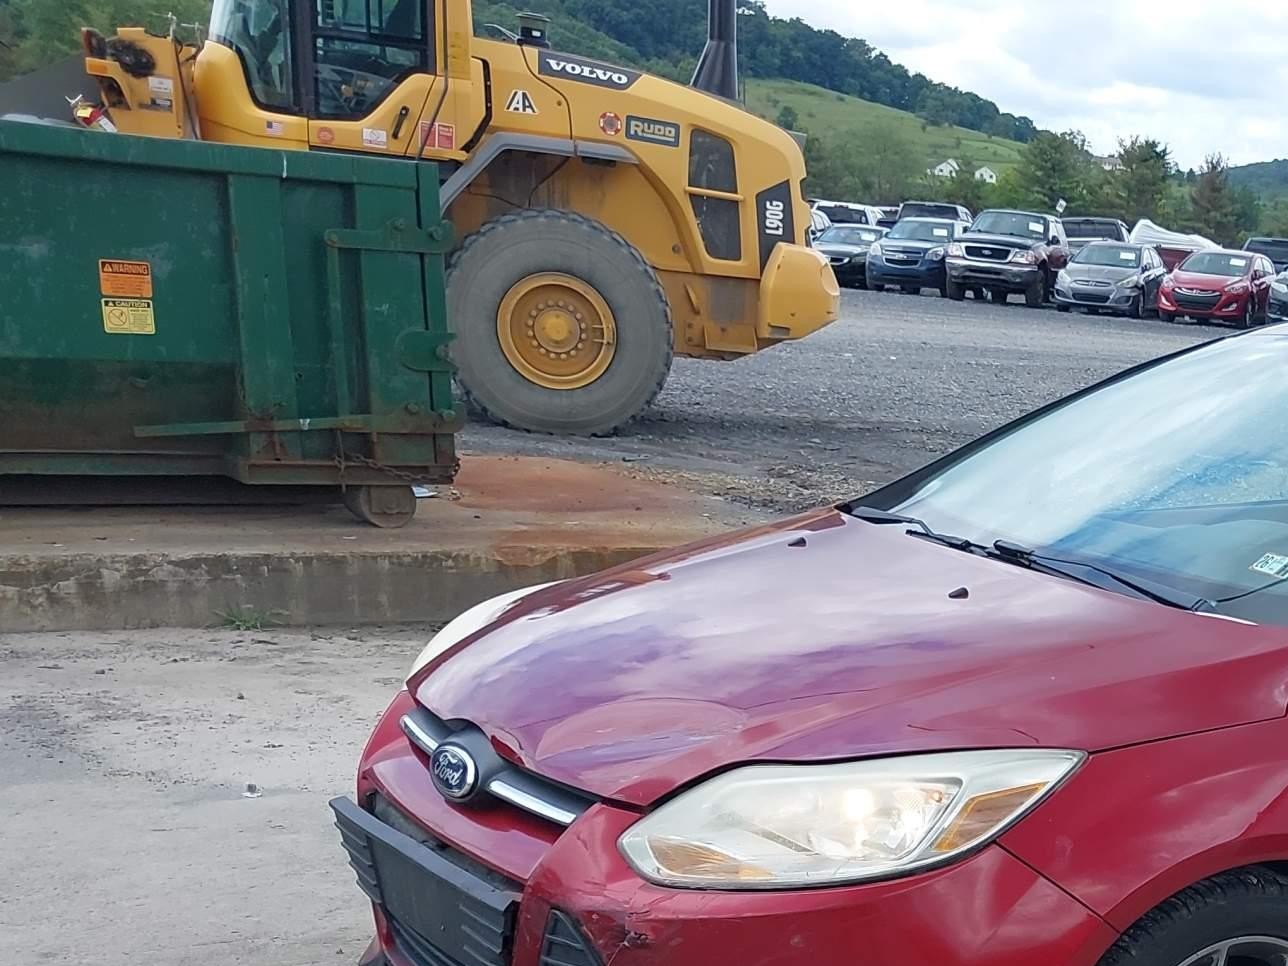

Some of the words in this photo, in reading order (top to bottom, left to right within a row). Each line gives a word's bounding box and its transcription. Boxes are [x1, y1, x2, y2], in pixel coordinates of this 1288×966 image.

[546, 58, 628, 84] VOLVO
[765, 200, 784, 236] L90G
[112, 263, 147, 274] WARNING
[434, 752, 463, 785] Ford
